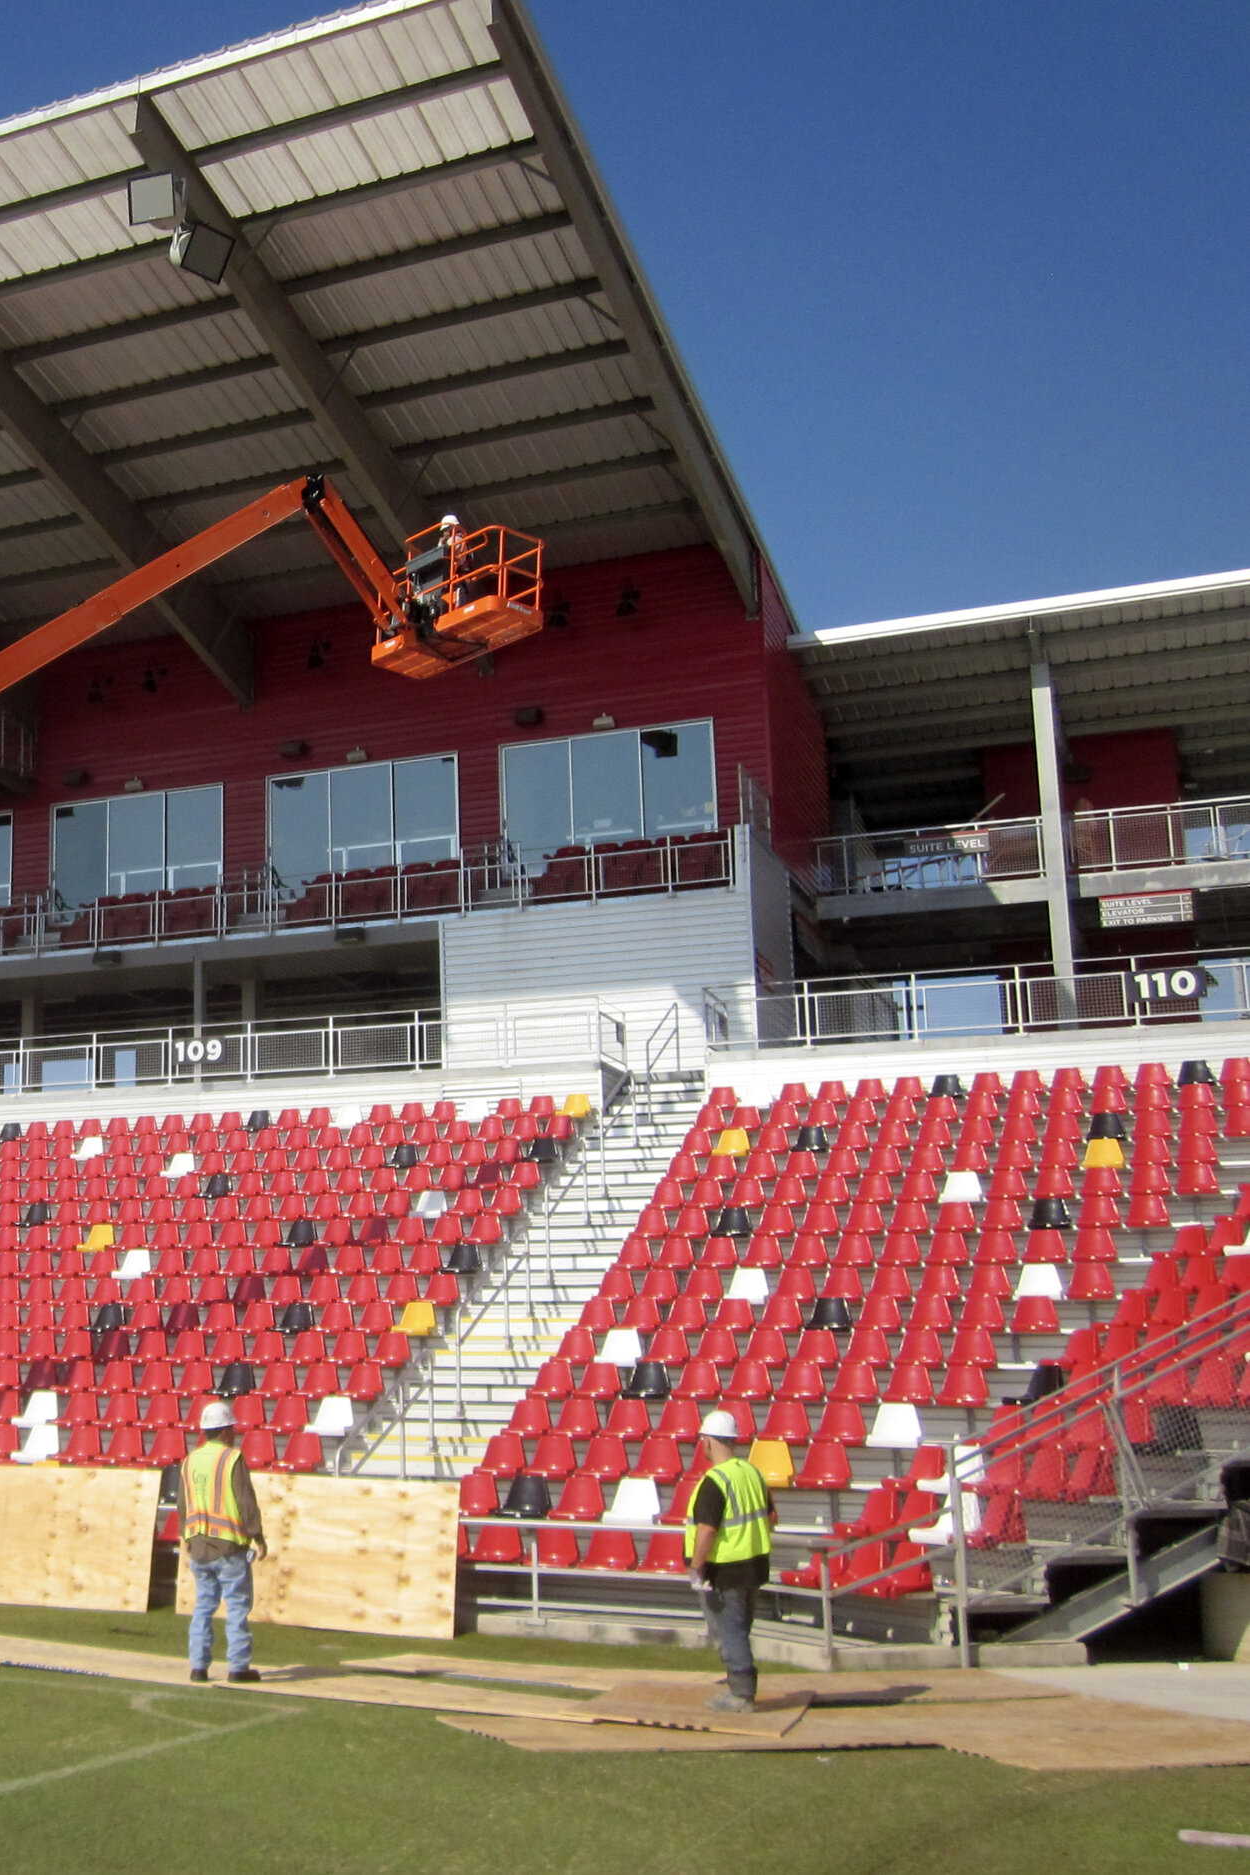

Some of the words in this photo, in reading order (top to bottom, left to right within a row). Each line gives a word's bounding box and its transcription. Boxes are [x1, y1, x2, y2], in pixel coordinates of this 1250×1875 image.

[909, 842, 943, 854] SUITE
[947, 839, 985, 851] LEVEL
[1101, 900, 1126, 909] SUITE
[1127, 898, 1153, 907] LEVEL
[1102, 908, 1145, 917] ELEVATOR
[1103, 918, 1121, 927] EXIT
[1136, 914, 1174, 924] PARKING
[1133, 970, 1196, 998] 110
[175, 1039, 222, 1062] 109
